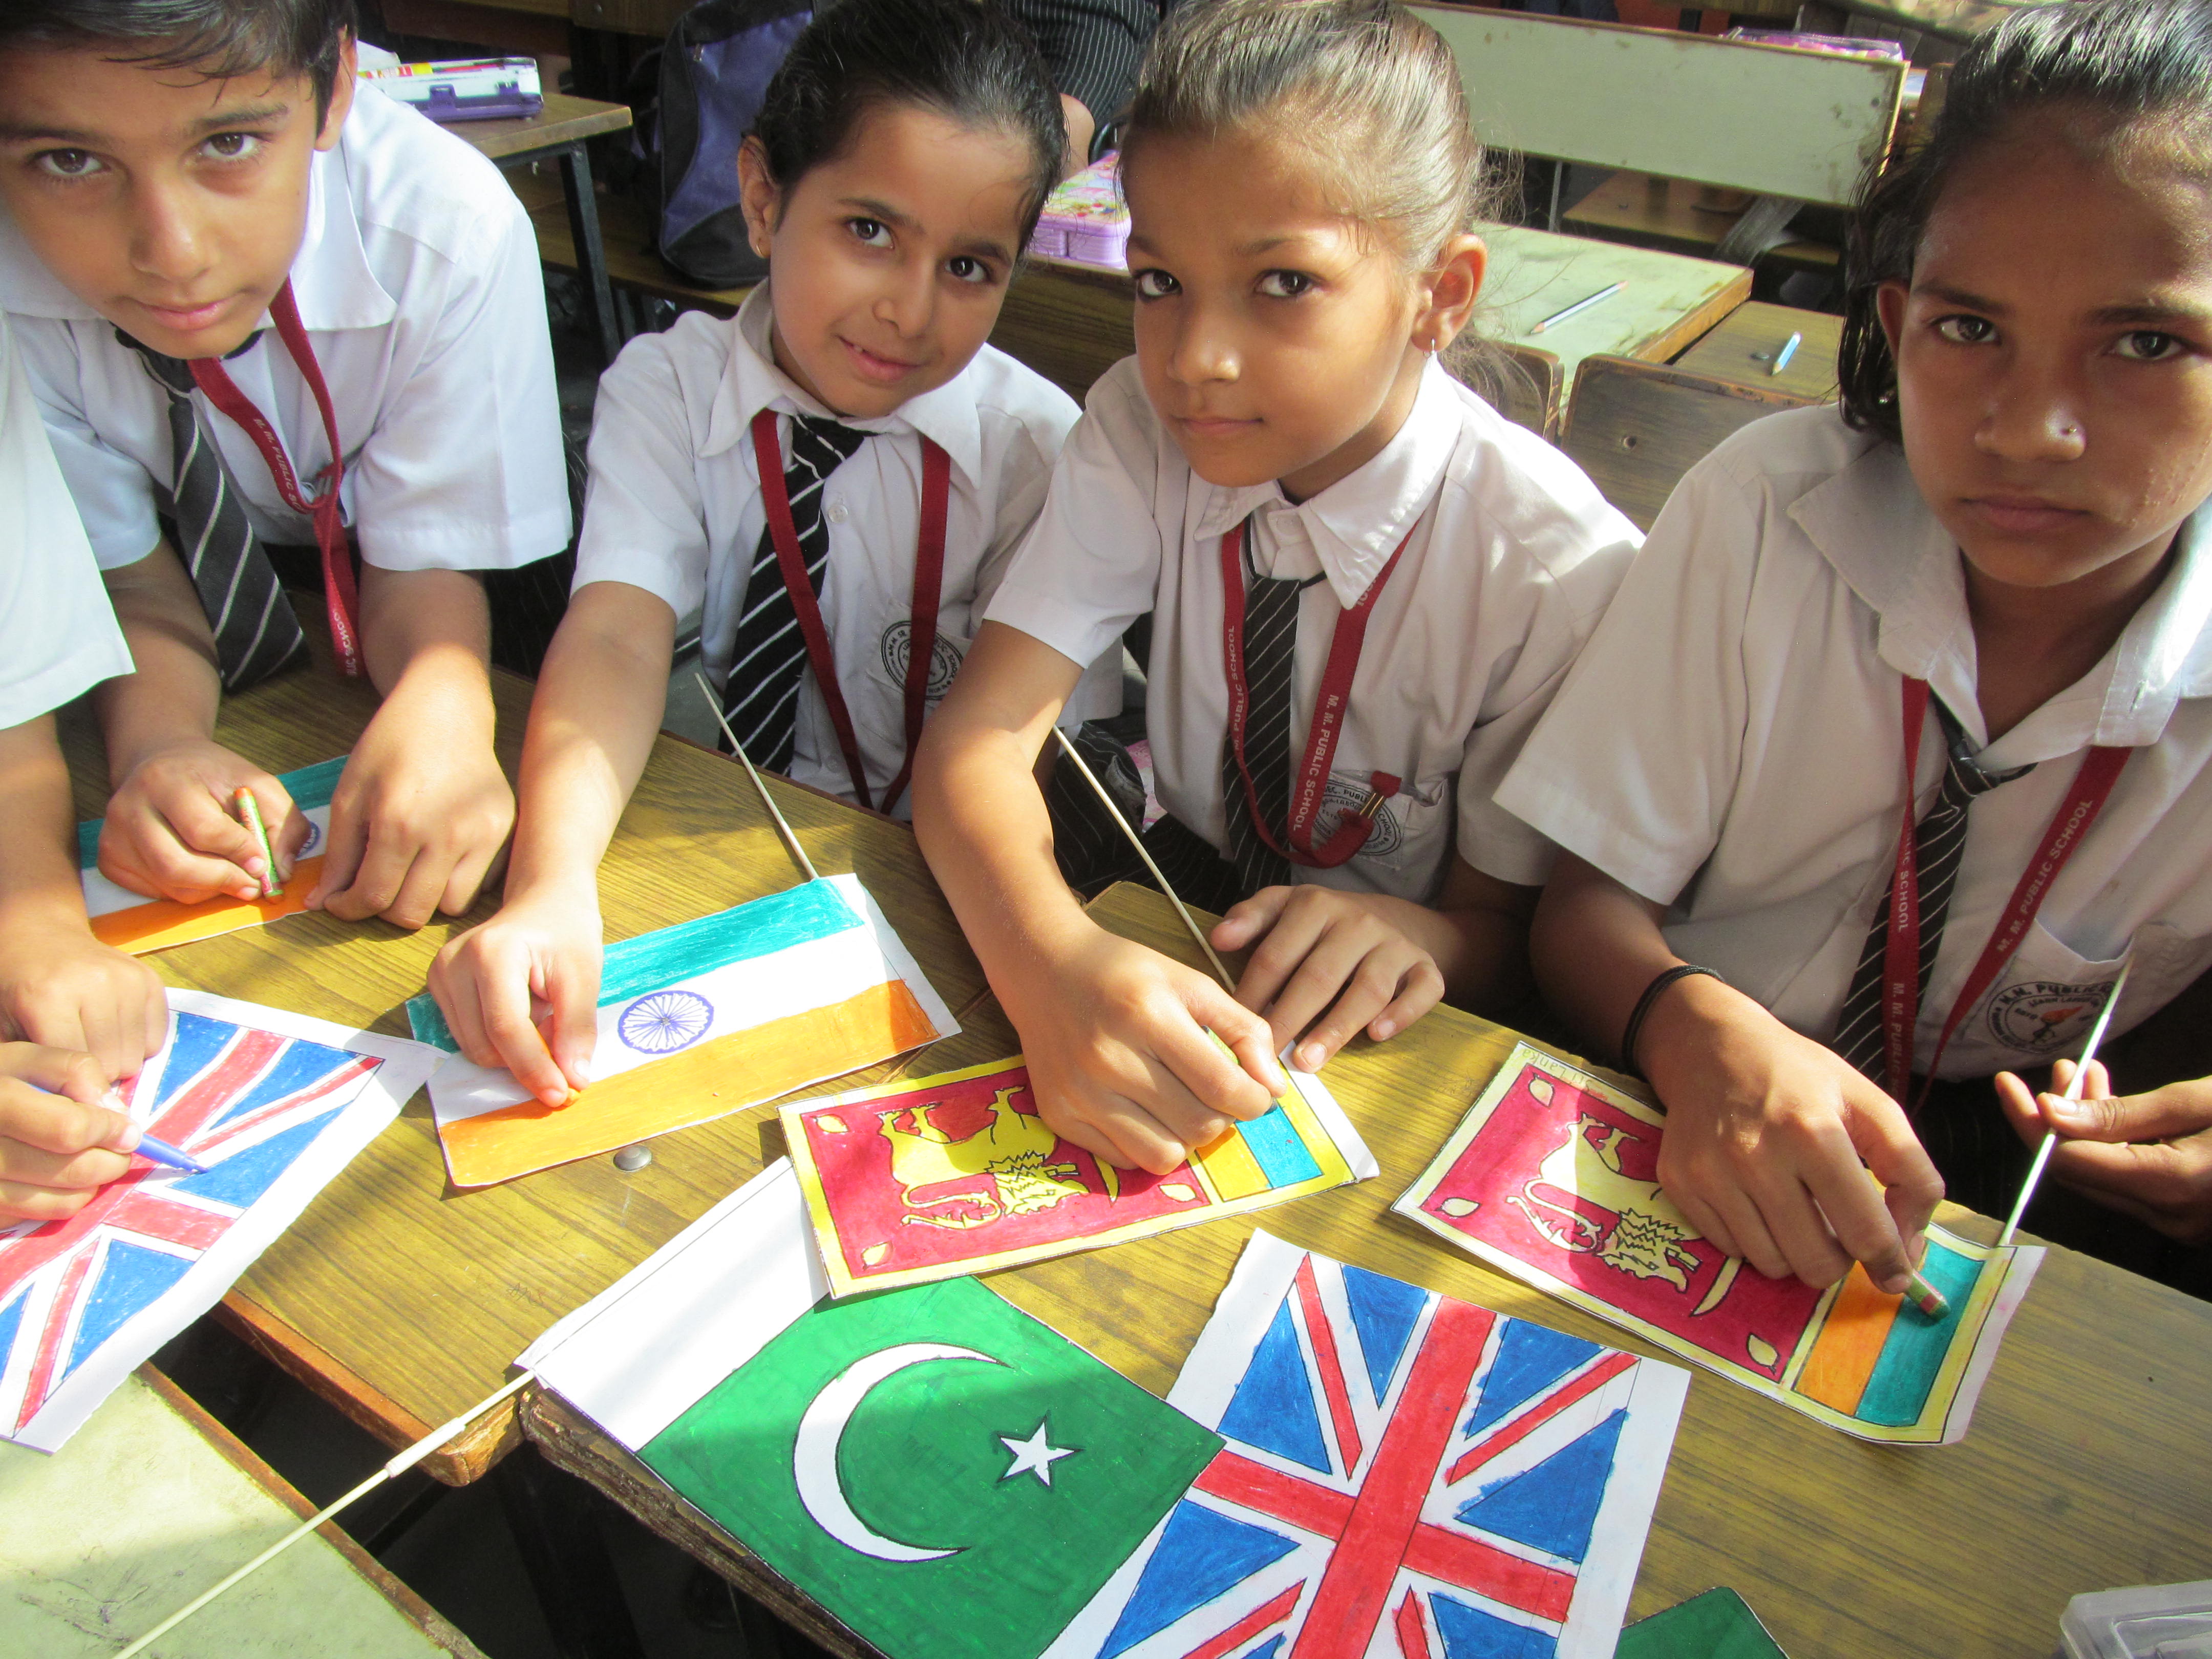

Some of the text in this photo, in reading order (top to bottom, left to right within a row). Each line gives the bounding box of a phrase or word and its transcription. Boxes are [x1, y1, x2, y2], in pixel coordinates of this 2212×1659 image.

[272, 446, 294, 491] PUBLIC
[1228, 625, 1239, 680] SCHOOL
[1233, 684, 1244, 732] PUBLIC
[1293, 694, 1339, 832] M. M. PUBLIC SCHOOL
[1343, 789, 1368, 803] PUBLI
[1997, 800, 2094, 952] M. M. PUBLIC SCHOOL
[1898, 870, 1909, 933] SCHOOL
[1893, 983, 1905, 997] M.
[1522, 1048, 1567, 1078] Lanka
[1891, 1022, 1902, 1073] PUBLIC
